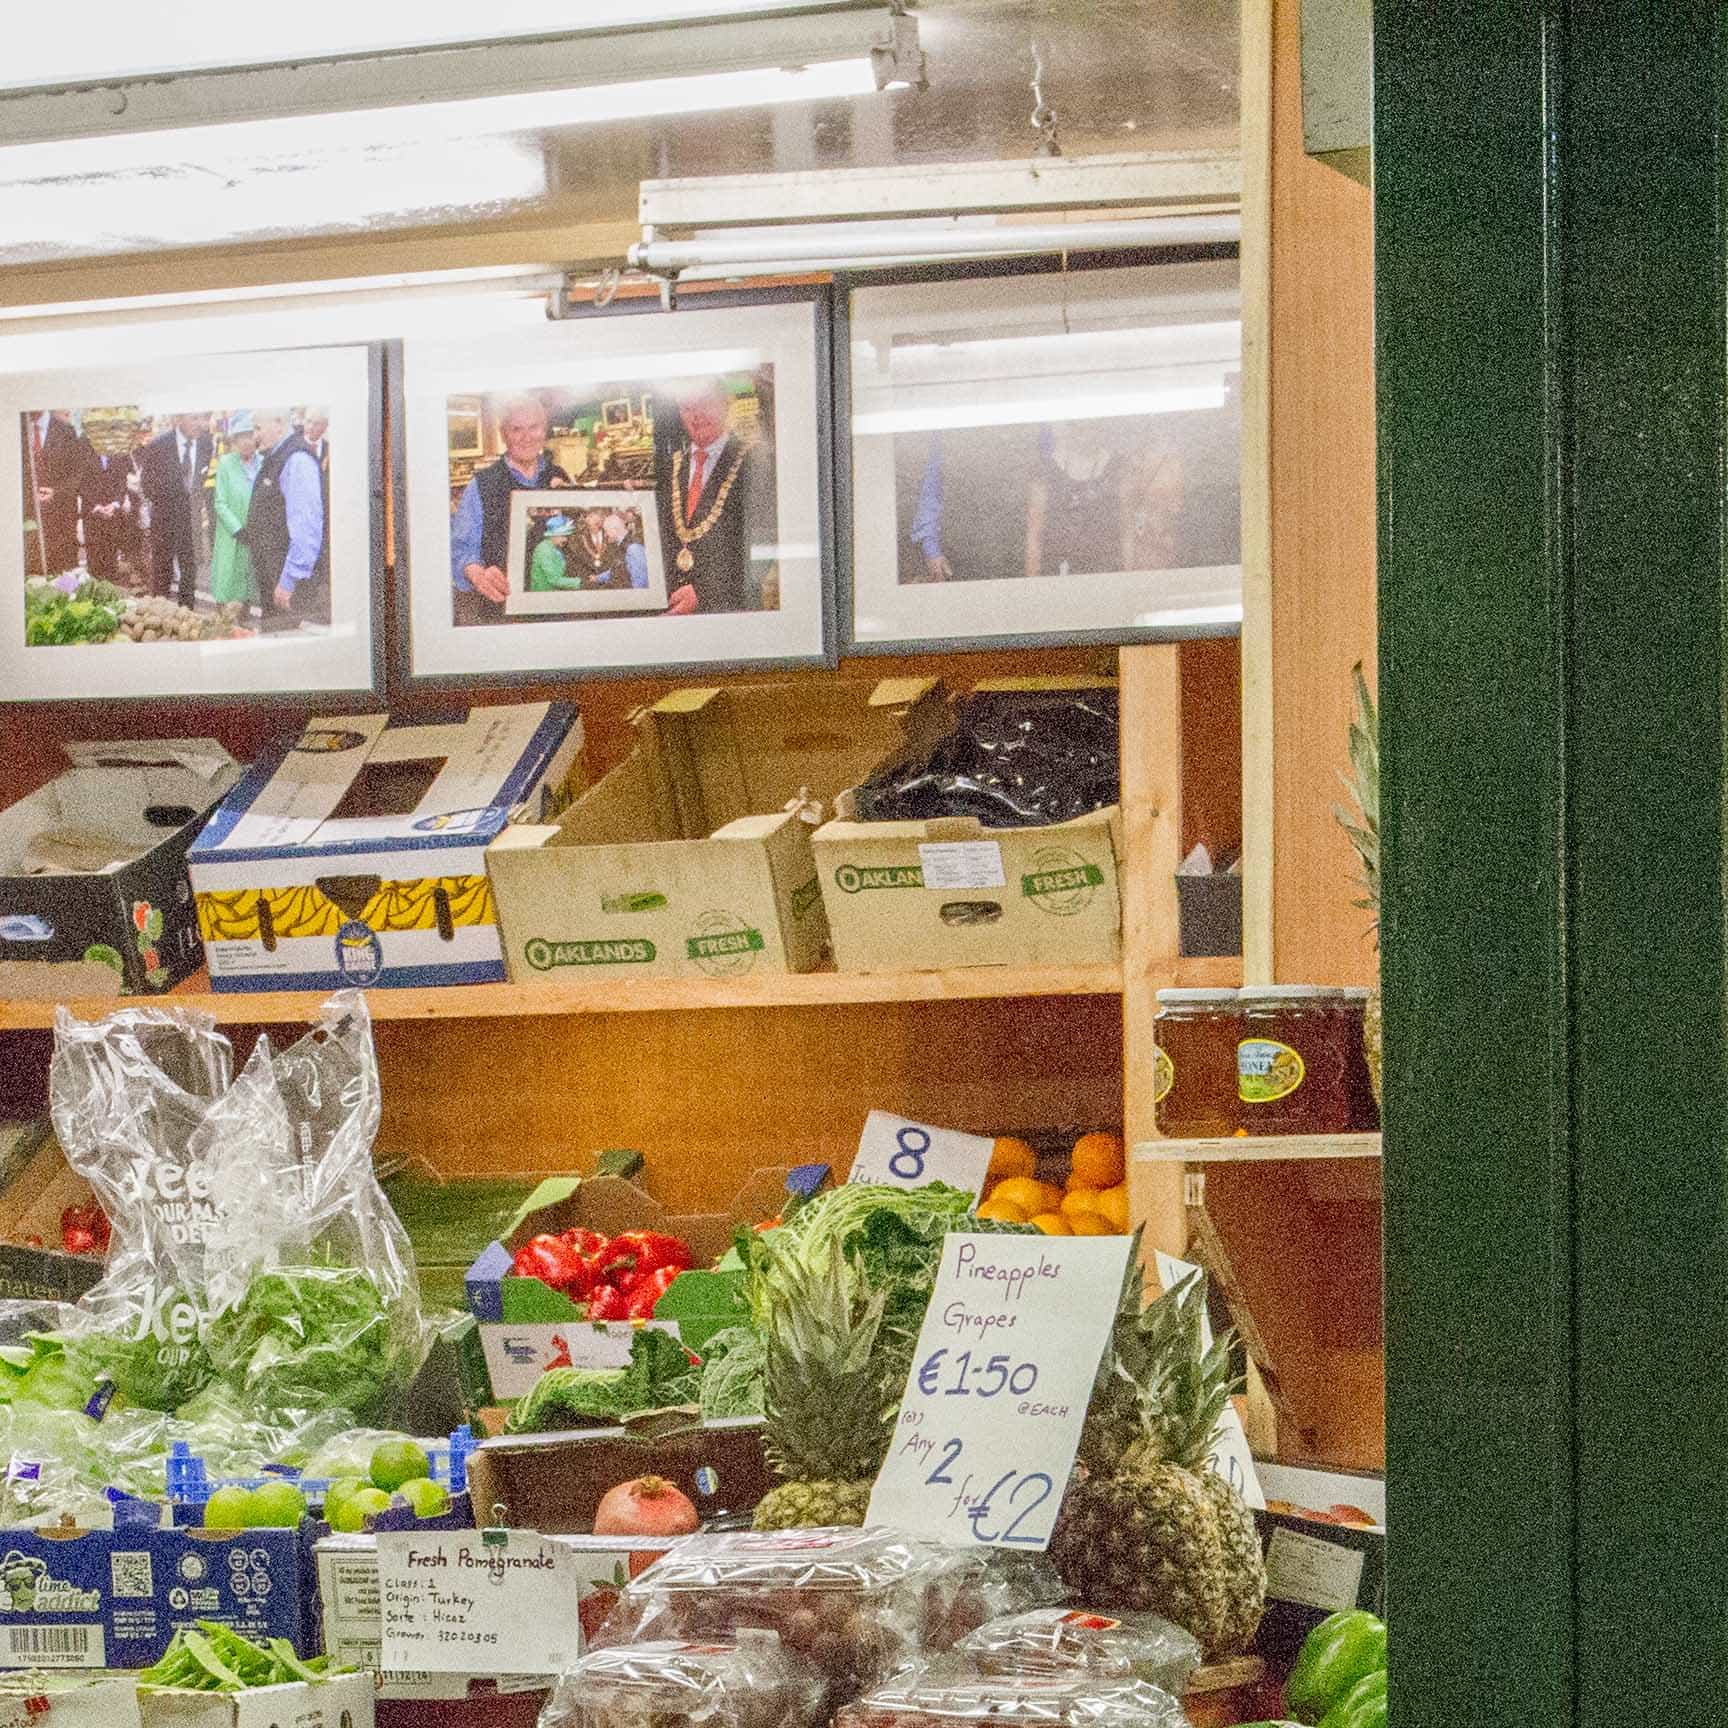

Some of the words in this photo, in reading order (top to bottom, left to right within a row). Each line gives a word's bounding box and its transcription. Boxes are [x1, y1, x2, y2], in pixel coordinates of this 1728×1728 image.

[836, 865, 924, 894] OAKLAN
[1033, 868, 1088, 893] FRESH
[526, 938, 646, 970] OAKLANDS
[698, 934, 751, 957] FRESH
[888, 1127, 931, 1179] 8
[956, 1242, 1061, 1302] Pineapples
[943, 1302, 1018, 1341] Grapes
[905, 1430, 937, 1467] Any
[925, 1438, 964, 1486] 2
[967, 1469, 1054, 1545] €2
[407, 1545, 448, 1569] Fresh
[457, 1546, 556, 1578] Pomegranate
[428, 1591, 475, 1612] Turkey
